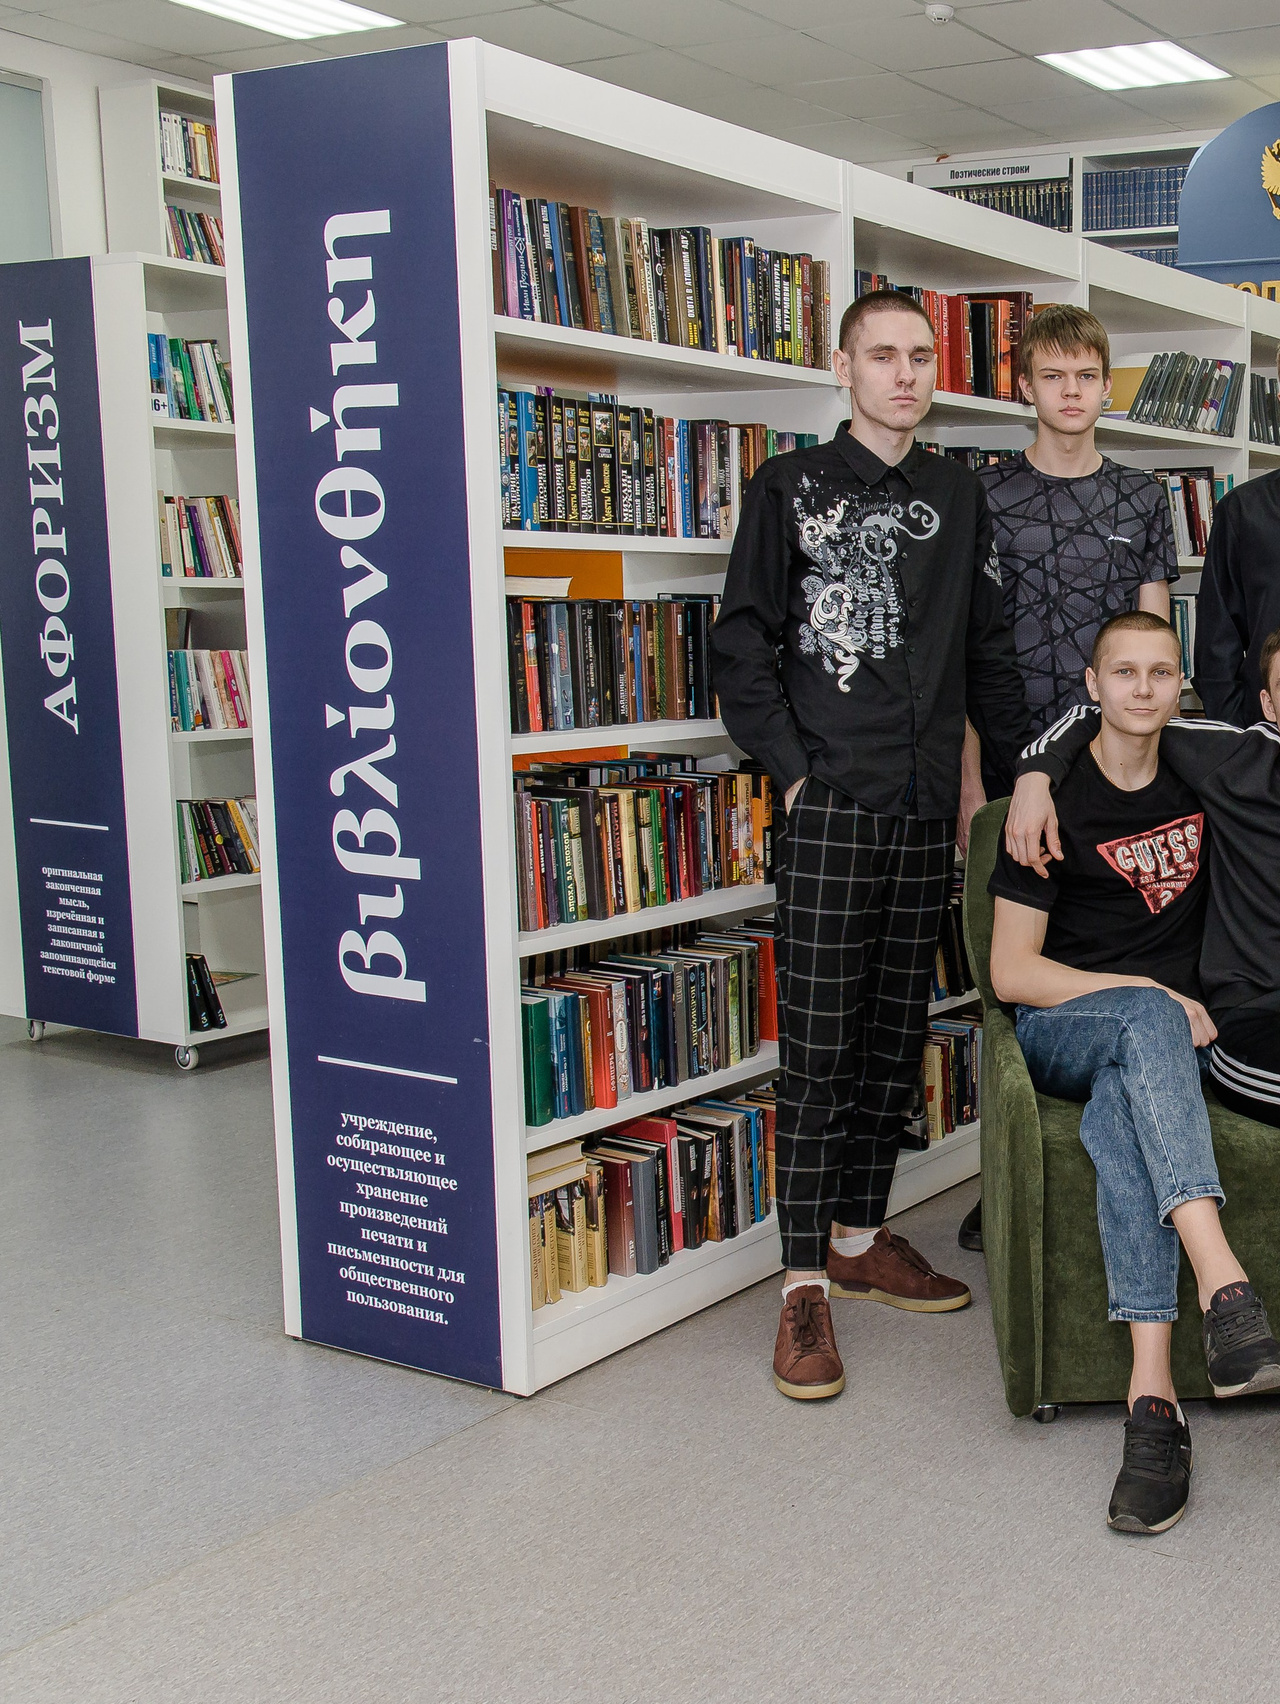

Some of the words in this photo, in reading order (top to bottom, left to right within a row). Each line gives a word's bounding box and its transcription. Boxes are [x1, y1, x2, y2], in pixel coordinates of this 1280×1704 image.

[949, 167, 1001, 180] Поэтические
[1001, 165, 1031, 176] строки
[541, 205, 550, 222] ВОЛНЫ
[542, 223, 553, 250] ДУНАЙСКИЕ
[680, 234, 689, 250] АДУ
[518, 255, 530, 289] Грозный
[683, 251, 693, 286] АТОМНОМ
[523, 289, 531, 311] Иван
[645, 263, 653, 309] ЕКАТЕРИНА
[650, 308, 658, 342] МЕДИЧИ
[687, 295, 695, 318] ОХОТА
[783, 280, 791, 332] ШТУРМОВИК
[537, 463, 545, 519] ГРИГОРИЙ
[555, 463, 563, 519] ГРИГОРИЙ
[567, 460, 577, 491] Саянские
[601, 462, 611, 494] Саянские
[509, 473, 518, 518] ВАЛЕРИЙ
[569, 493, 579, 520] Хребты
[580, 477, 589, 521] ВАЛЕРИЙ
[602, 495, 612, 522] Хребты
[621, 469, 629, 523] МИХАИЛ
[684, 486, 692, 535] ЕКАТЕРИНА
[19, 317, 79, 735] АФОРИЗМ
[634, 498, 642, 529] ЖЕЛЕЗНЫЙ
[611, 801, 622, 859] ВИКТОРИЯ
[1116, 824, 1199, 878] GUESS
[42, 867, 103, 881] оригинальная
[46, 882, 101, 895] законченная
[46, 910, 96, 923] изречённая
[59, 898, 89, 910] мысль,
[48, 924, 100, 938] записанная
[51, 939, 103, 953] лаконичной
[40, 951, 116, 969] запоминающейся
[43, 966, 85, 978] текстовой
[87, 970, 115, 984] форме
[341, 1113, 437, 1144] учреждение,
[337, 1134, 431, 1162] собирающее
[435, 1153, 445, 1165] и
[327, 1155, 457, 1190] осуществляющее
[356, 1183, 428, 1207] хранение
[340, 1201, 448, 1234] произведений
[361, 1228, 413, 1249] печати
[417, 1241, 427, 1252] и
[530, 1222, 538, 1245] СНЕГА
[547, 1210, 556, 1274] ЧУЖЕСТРАНКА
[576, 1229, 584, 1262] ДЫХАНИЕ
[328, 1243, 434, 1276] письменности
[438, 1268, 465, 1284] для
[531, 1247, 539, 1280] ДЫХАНИЕ
[340, 1266, 454, 1303] общественного
[347, 1291, 448, 1325] пользования.
